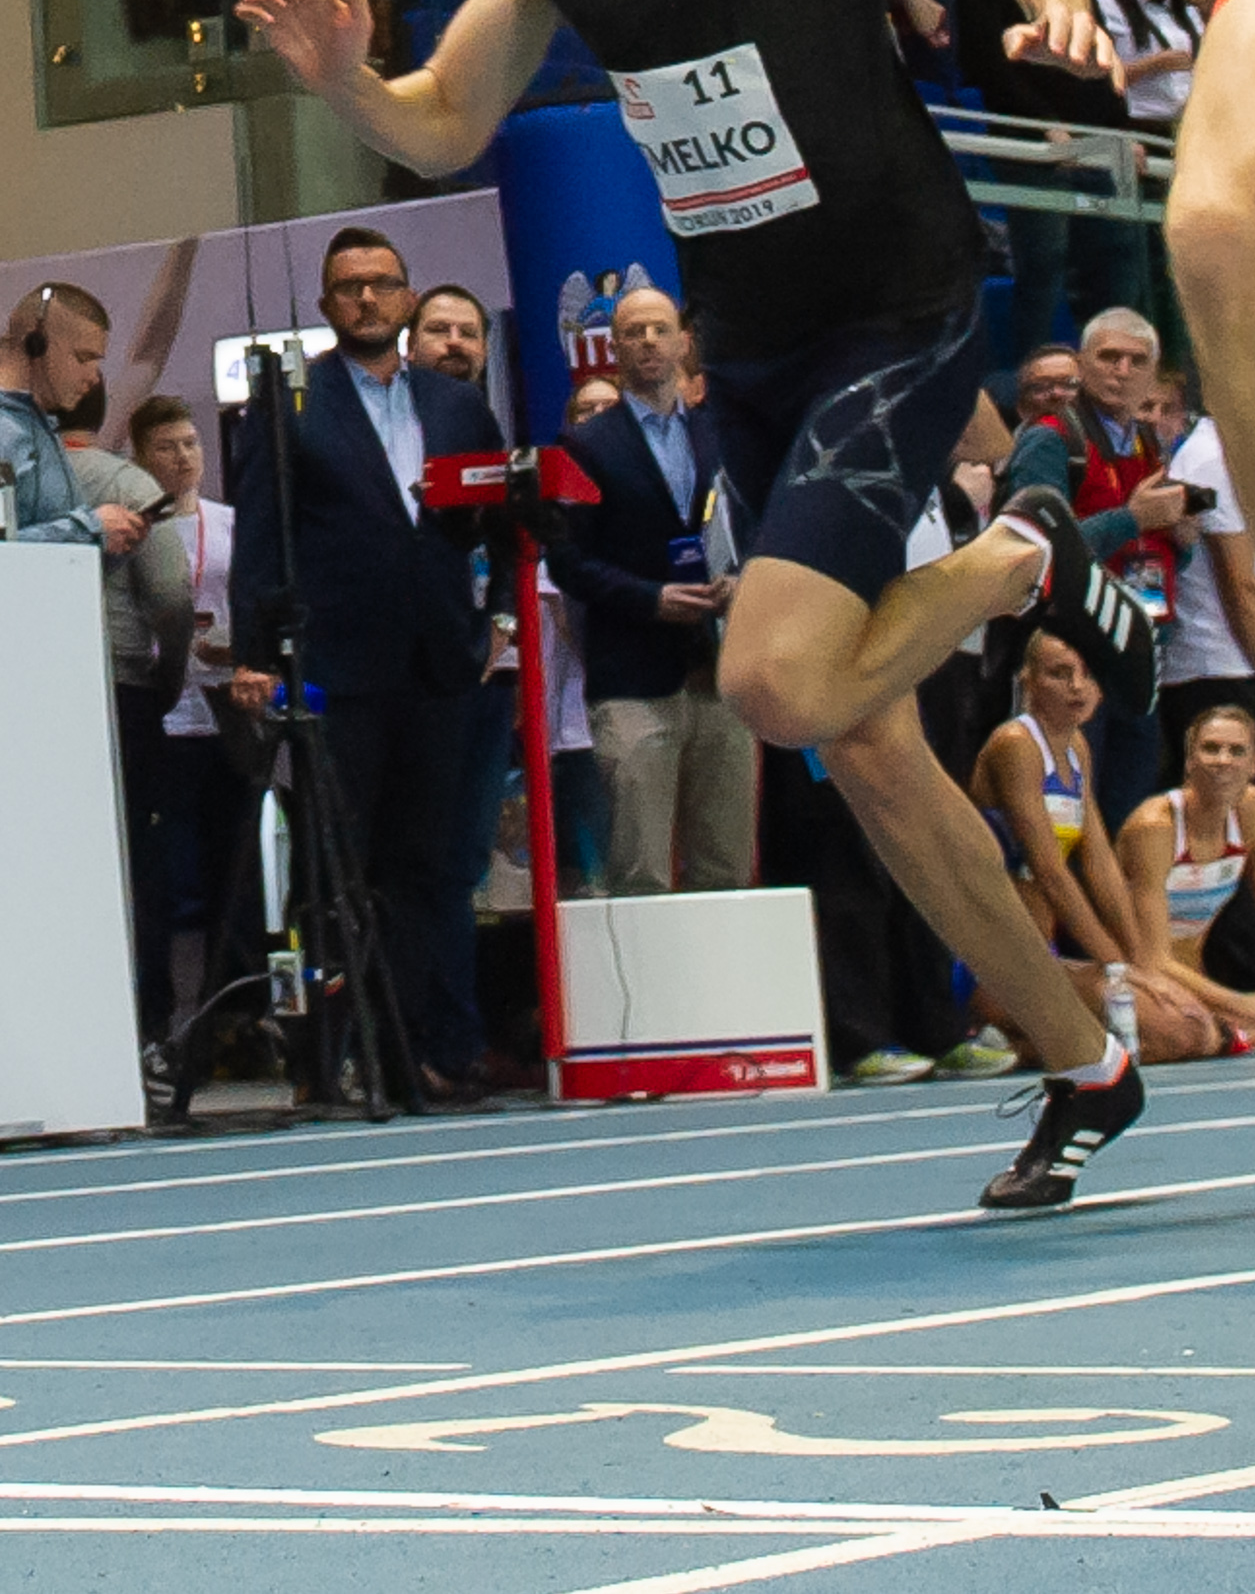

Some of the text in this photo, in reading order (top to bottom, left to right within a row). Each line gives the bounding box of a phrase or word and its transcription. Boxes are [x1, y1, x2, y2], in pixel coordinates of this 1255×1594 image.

[683, 60, 741, 106] 11
[644, 120, 776, 176] MELKO
[730, 199, 775, 225] 2019
